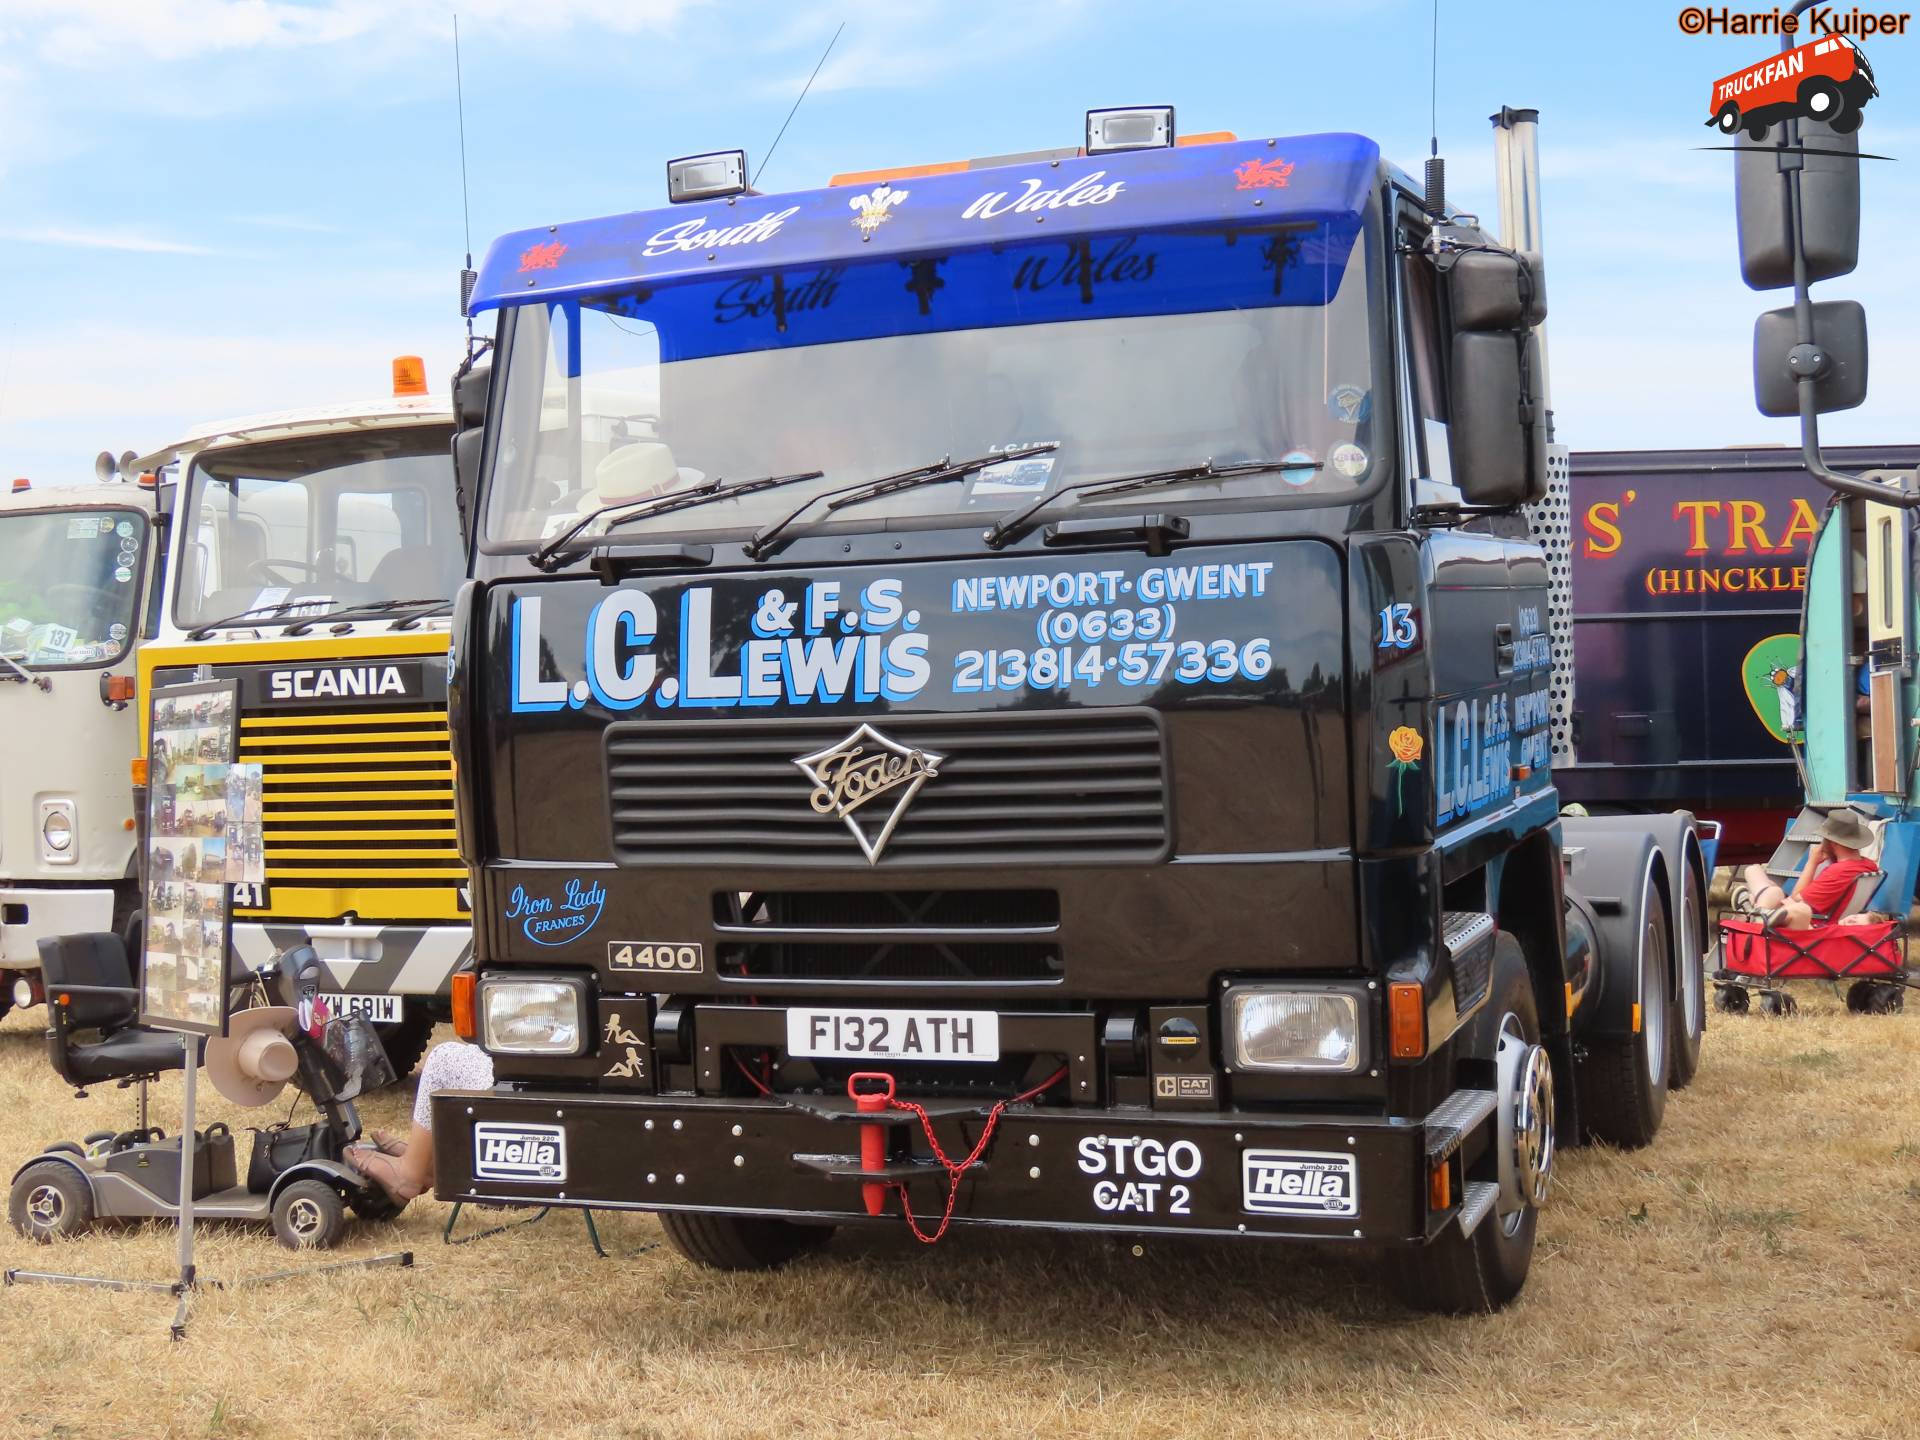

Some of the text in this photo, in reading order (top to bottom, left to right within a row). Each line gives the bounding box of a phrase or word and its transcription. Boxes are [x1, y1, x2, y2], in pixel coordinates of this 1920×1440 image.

[642, 171, 1127, 257] South Wales
[1569, 489, 1819, 559] S' TRA
[48, 629, 72, 651] 137
[1036, 603, 1176, 647] (0633)
[1378, 602, 1417, 649] 13
[272, 667, 406, 699] SCANIA
[810, 745, 940, 819] Foden
[506, 883, 552, 918] Iron
[560, 878, 606, 912] Lady
[534, 914, 586, 934] FRANCES
[615, 945, 697, 969] 4400
[810, 1016, 974, 1054] F132 ATH
[1181, 1079, 1209, 1089] CAT
[485, 1139, 555, 1164] Hella
[1078, 1136, 1203, 1179] STGO
[1299, 1163, 1344, 1172] Jumbo 220
[1093, 1181, 1191, 1215] CAT 2
[1255, 1168, 1344, 1197] Hella
